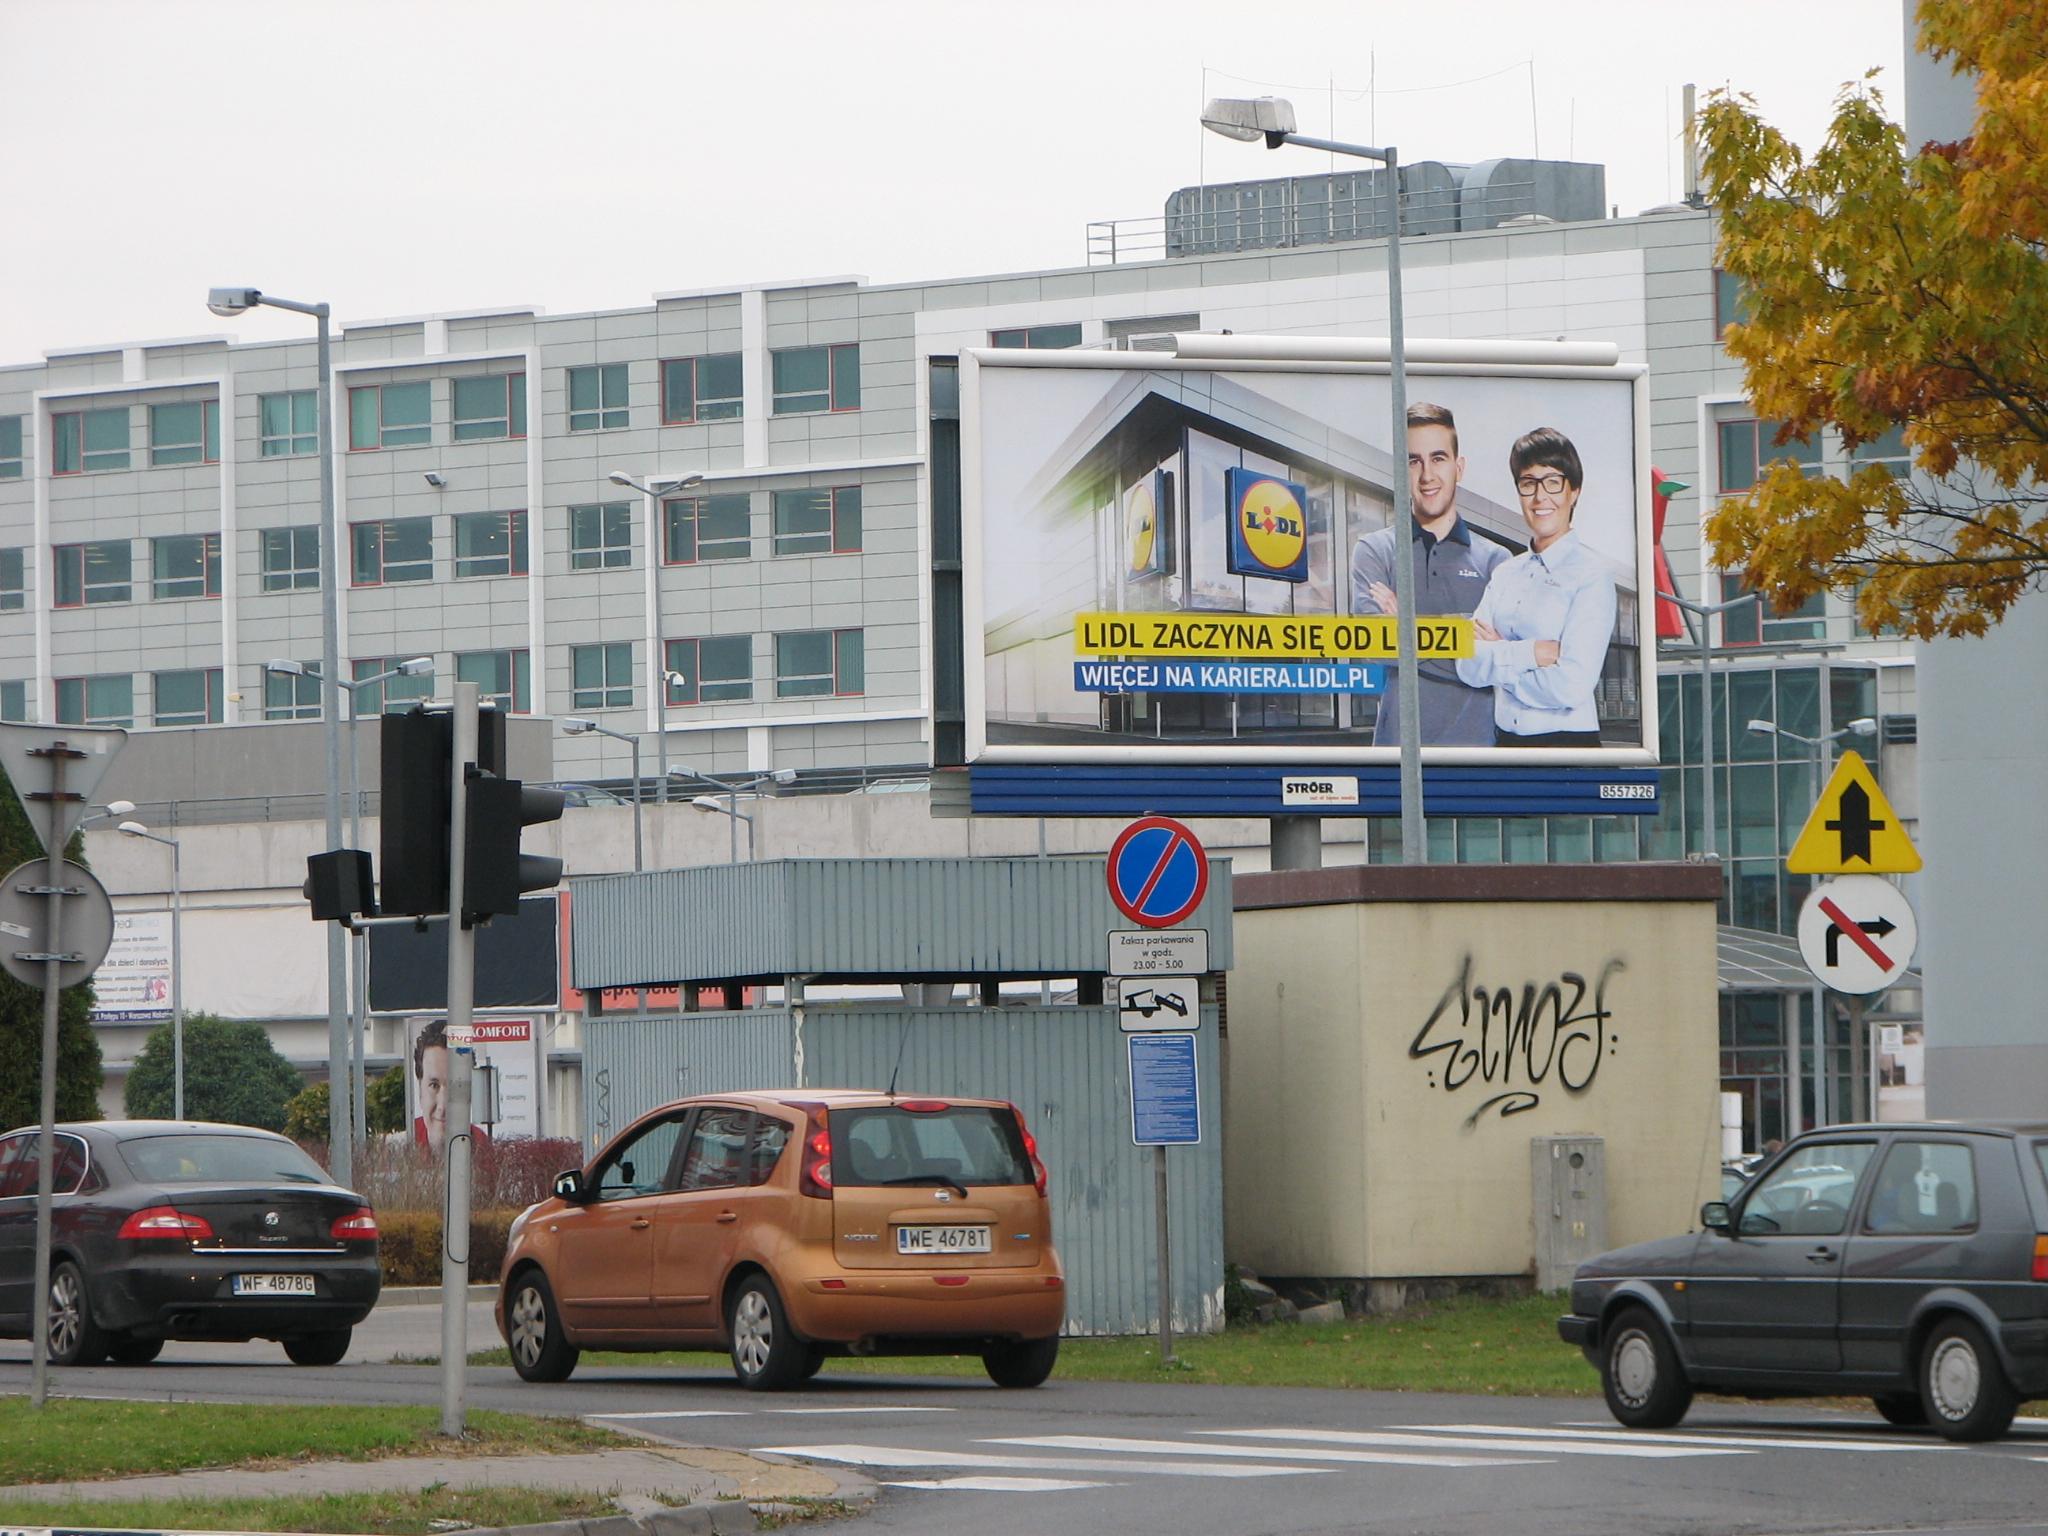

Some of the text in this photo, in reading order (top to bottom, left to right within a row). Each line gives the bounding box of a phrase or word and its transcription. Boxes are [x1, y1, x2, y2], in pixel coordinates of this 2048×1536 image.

[1084, 622, 1458, 658] LIDL ZACZYNA SIĘ OD LDZI
[1081, 665, 1375, 692] WIĘCEJ NA KARIERA.LIDL.PL
[1602, 786, 1653, 798] 8557326
[1120, 934, 1194, 947] Zakaz parkowania
[1151, 947, 1174, 959] godz.
[1133, 960, 1156, 970] 23.00
[1165, 959, 1184, 969] 5.00
[909, 1229, 987, 1247] WE 4678T
[242, 1275, 313, 1291] WF 4878G
